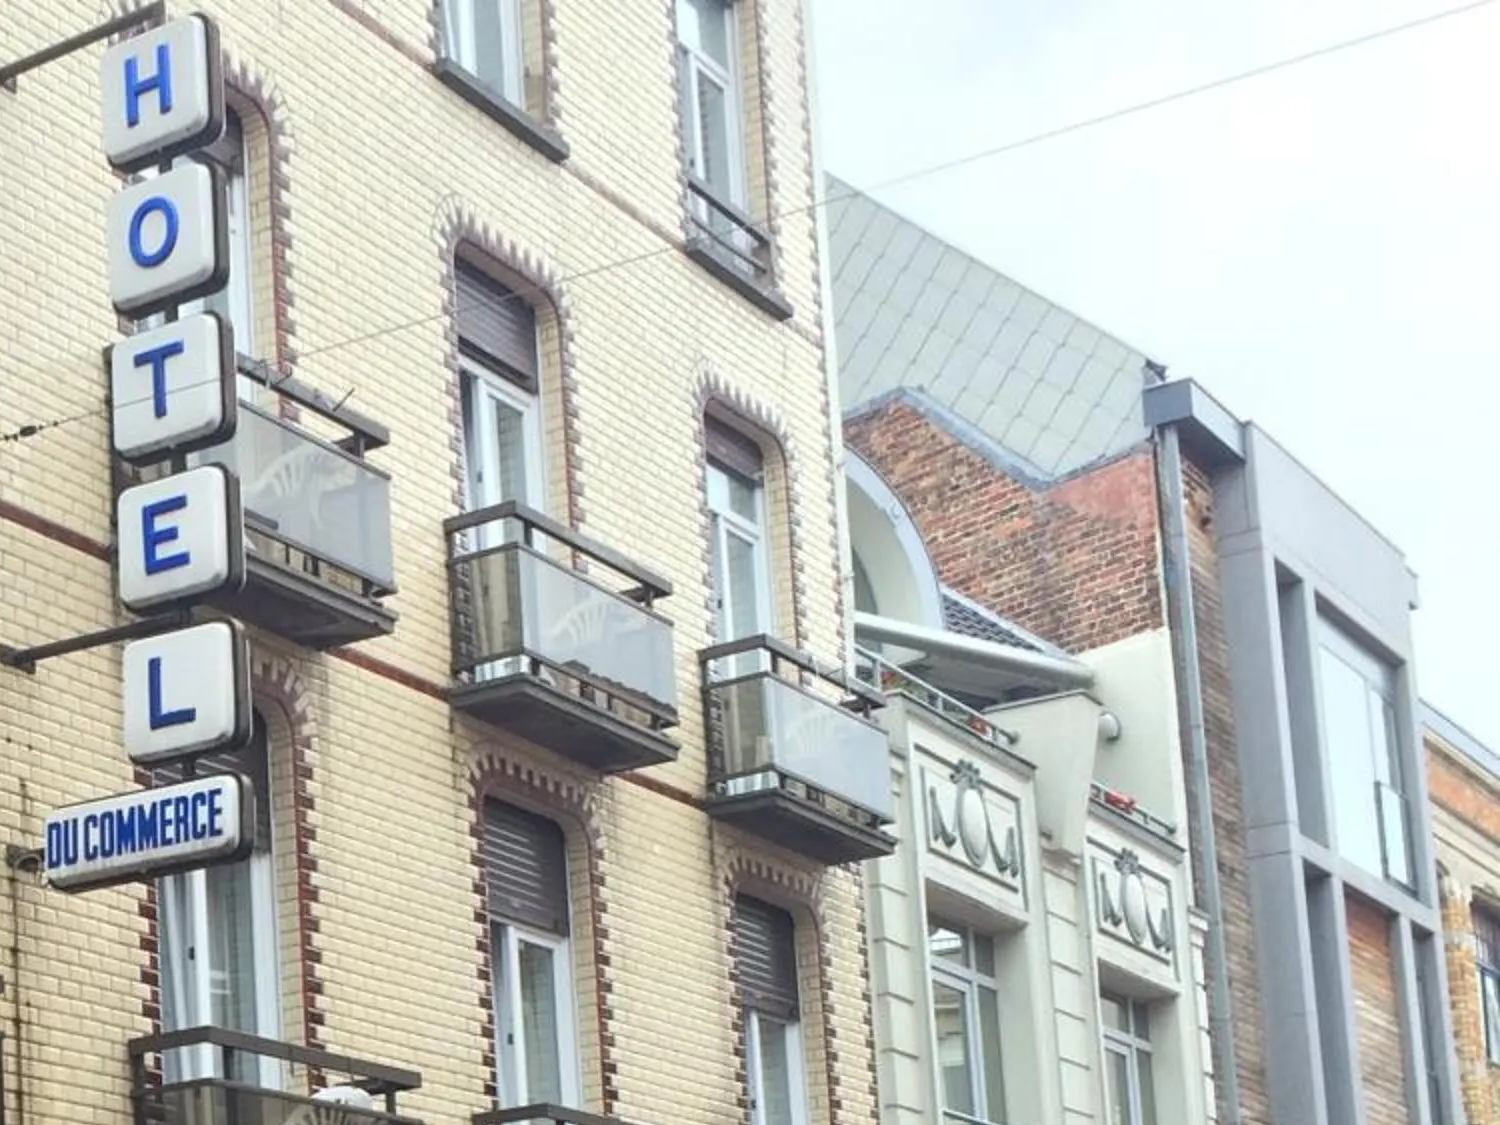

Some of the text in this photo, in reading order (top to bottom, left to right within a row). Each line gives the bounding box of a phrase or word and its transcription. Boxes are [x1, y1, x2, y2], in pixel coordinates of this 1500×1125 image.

[122, 42, 197, 731] HOTEL
[47, 787, 224, 869] DU COMMERCE
